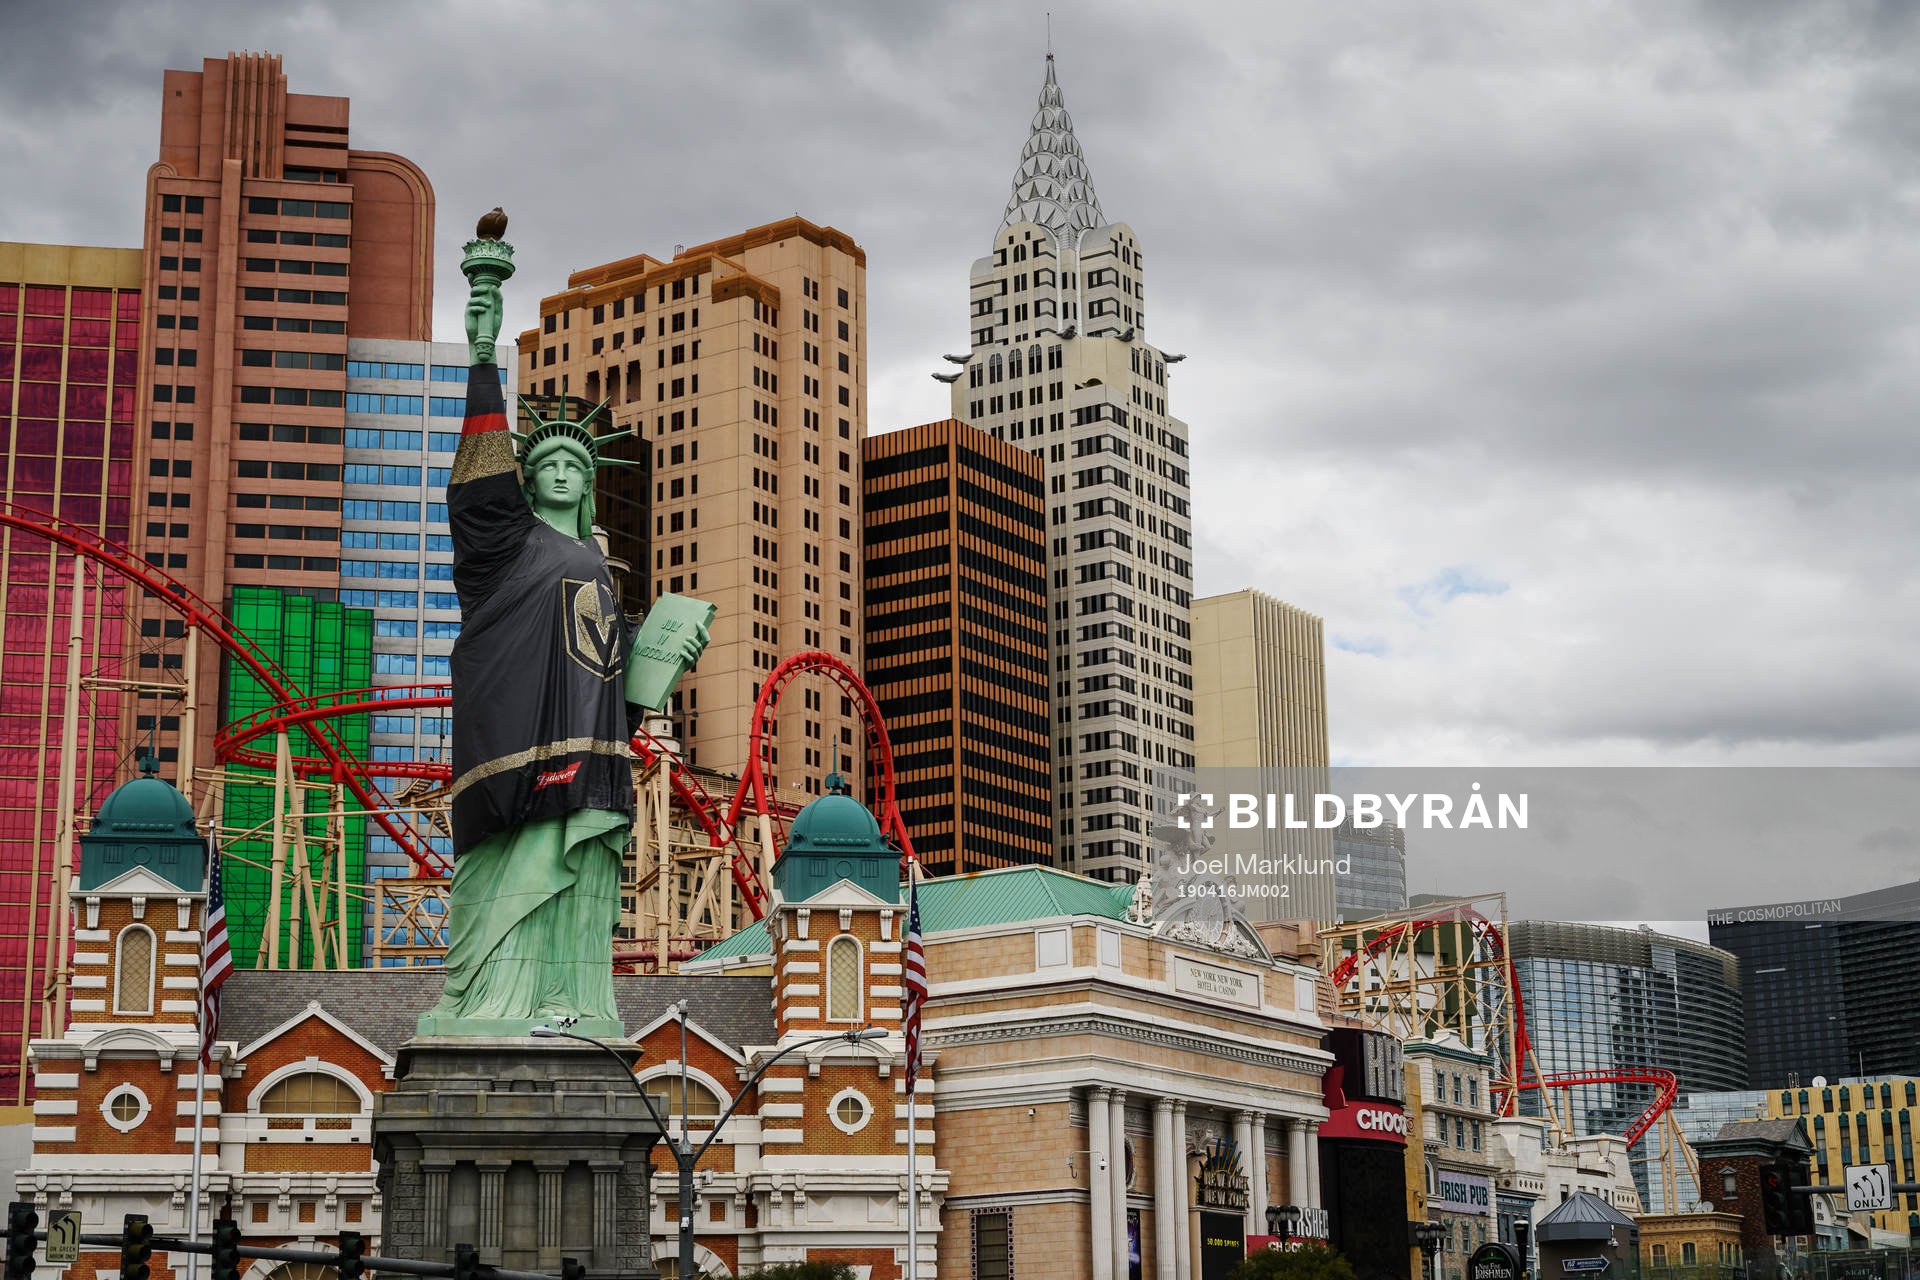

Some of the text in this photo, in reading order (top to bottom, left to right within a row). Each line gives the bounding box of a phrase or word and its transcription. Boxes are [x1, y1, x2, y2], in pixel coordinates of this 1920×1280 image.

[661, 618, 684, 632] JULY
[1709, 900, 1841, 926] THE COSMOPOLITAN
[1190, 967, 1243, 988] NEW YORK NEW YORK
[1197, 980, 1213, 992] HOTEL
[1218, 985, 1237, 997] CASINO
[1440, 1180, 1488, 1206] IRISH PUB
[1854, 1198, 1884, 1208] ONLY
